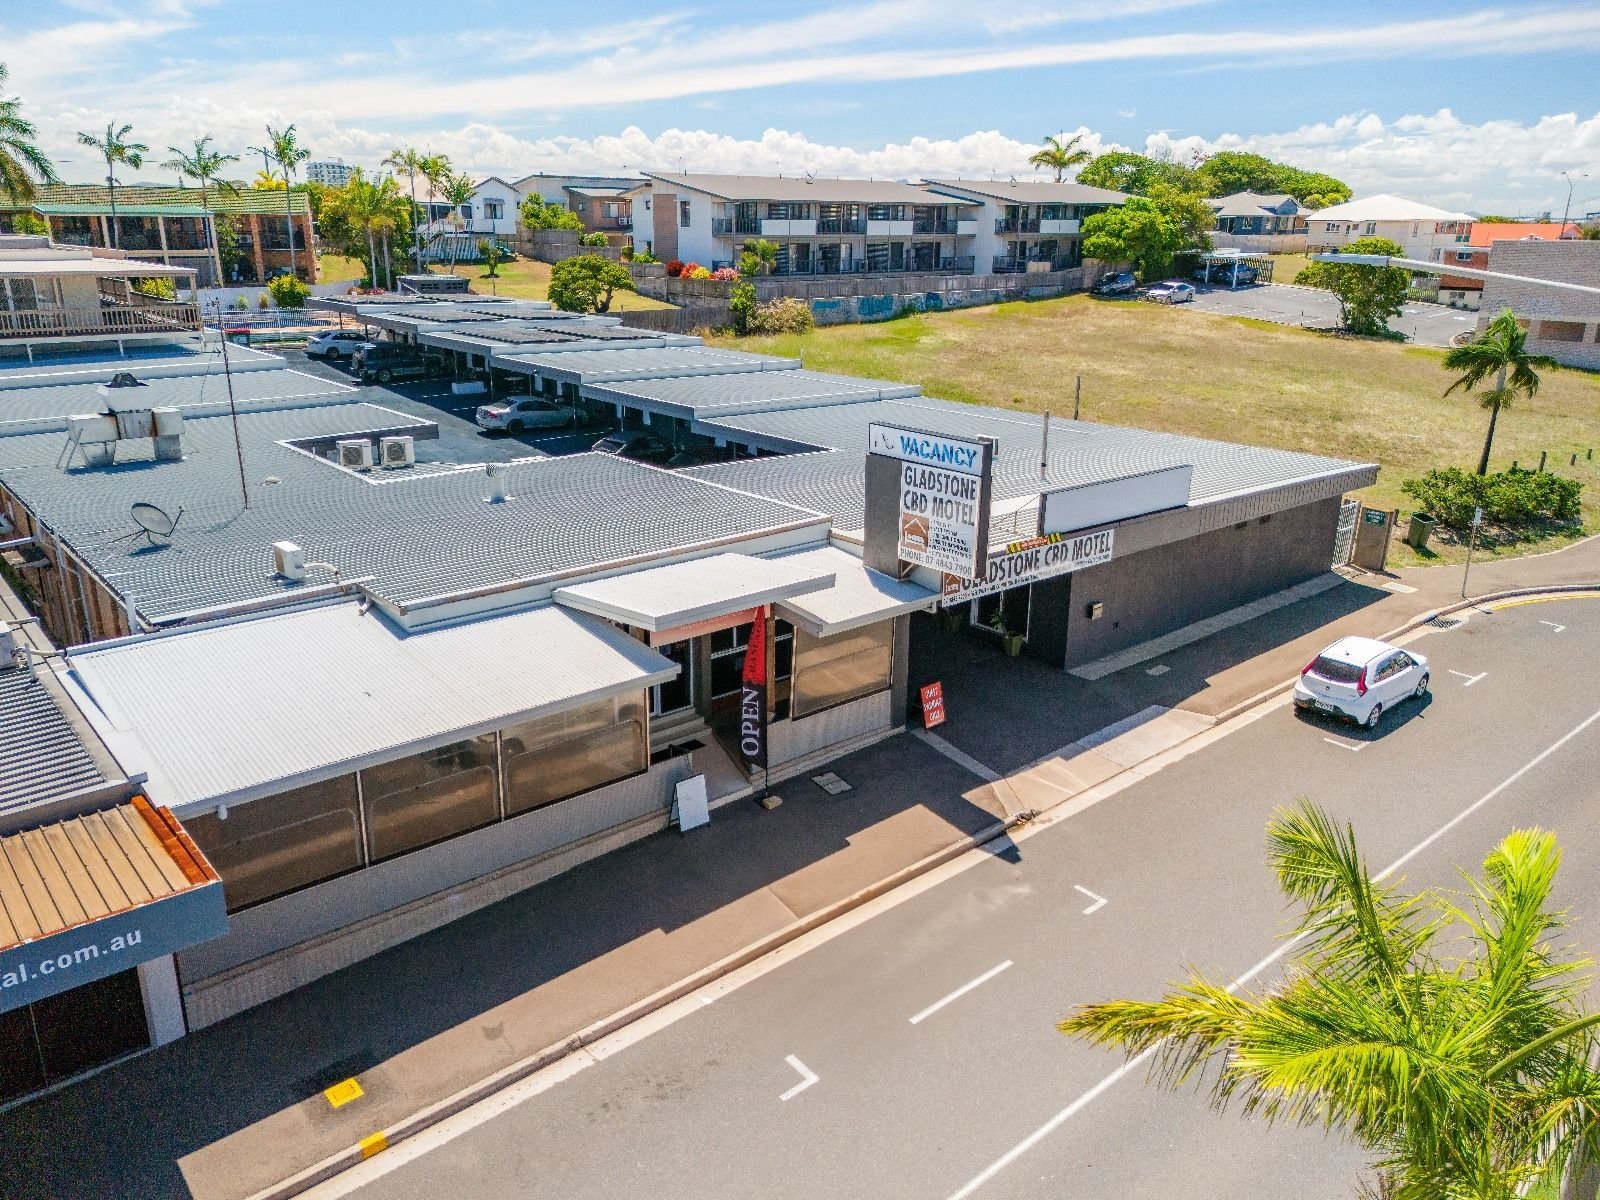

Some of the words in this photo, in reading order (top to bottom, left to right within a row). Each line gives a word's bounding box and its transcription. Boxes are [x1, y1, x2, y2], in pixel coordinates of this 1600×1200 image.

[900, 436, 977, 468] VACANCY
[904, 466, 977, 500] GLADSTONE
[903, 490, 928, 513] CBD
[931, 496, 975, 527] MOTEL
[900, 548, 924, 562] PHONE:
[925, 555, 934, 565] 07
[954, 563, 972, 576] 7900
[1044, 542, 1069, 566] CBD
[1071, 531, 1111, 561] MOTEL
[741, 687, 760, 756] OPEN
[0, 929, 142, 990] al.com.au
